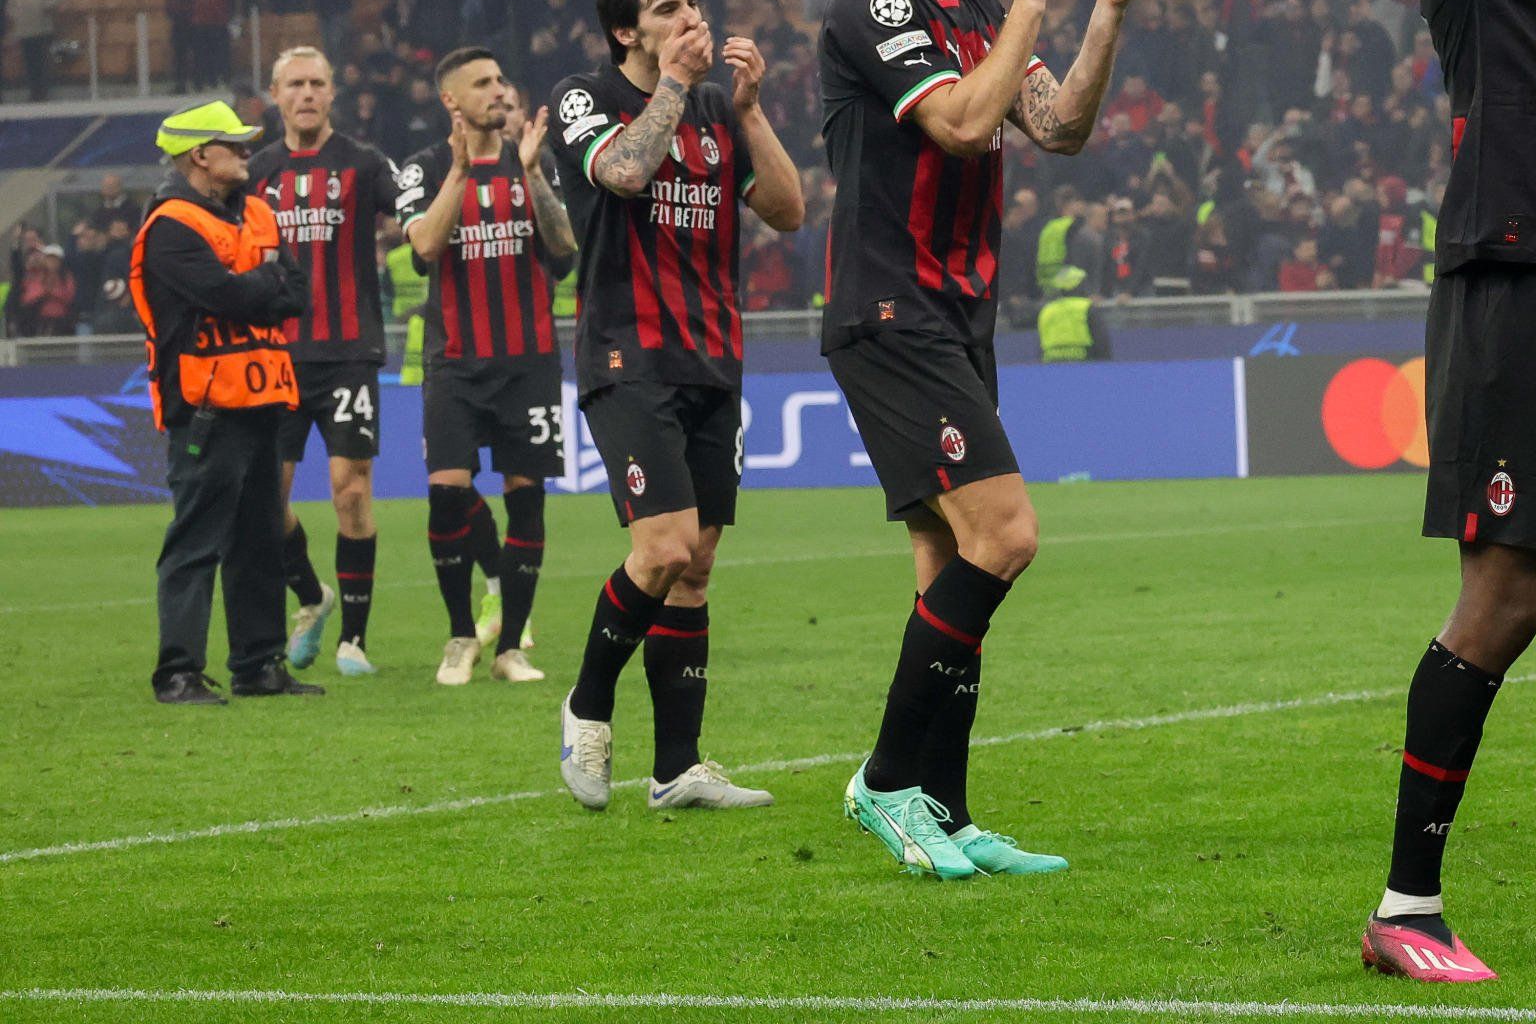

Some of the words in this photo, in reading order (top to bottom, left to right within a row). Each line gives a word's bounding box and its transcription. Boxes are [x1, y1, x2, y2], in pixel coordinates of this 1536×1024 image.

[650, 176, 722, 207] mirates
[274, 204, 346, 228] mirates
[649, 202, 671, 225] FLY
[674, 206, 715, 230] BETTER
[332, 384, 374, 423] 24
